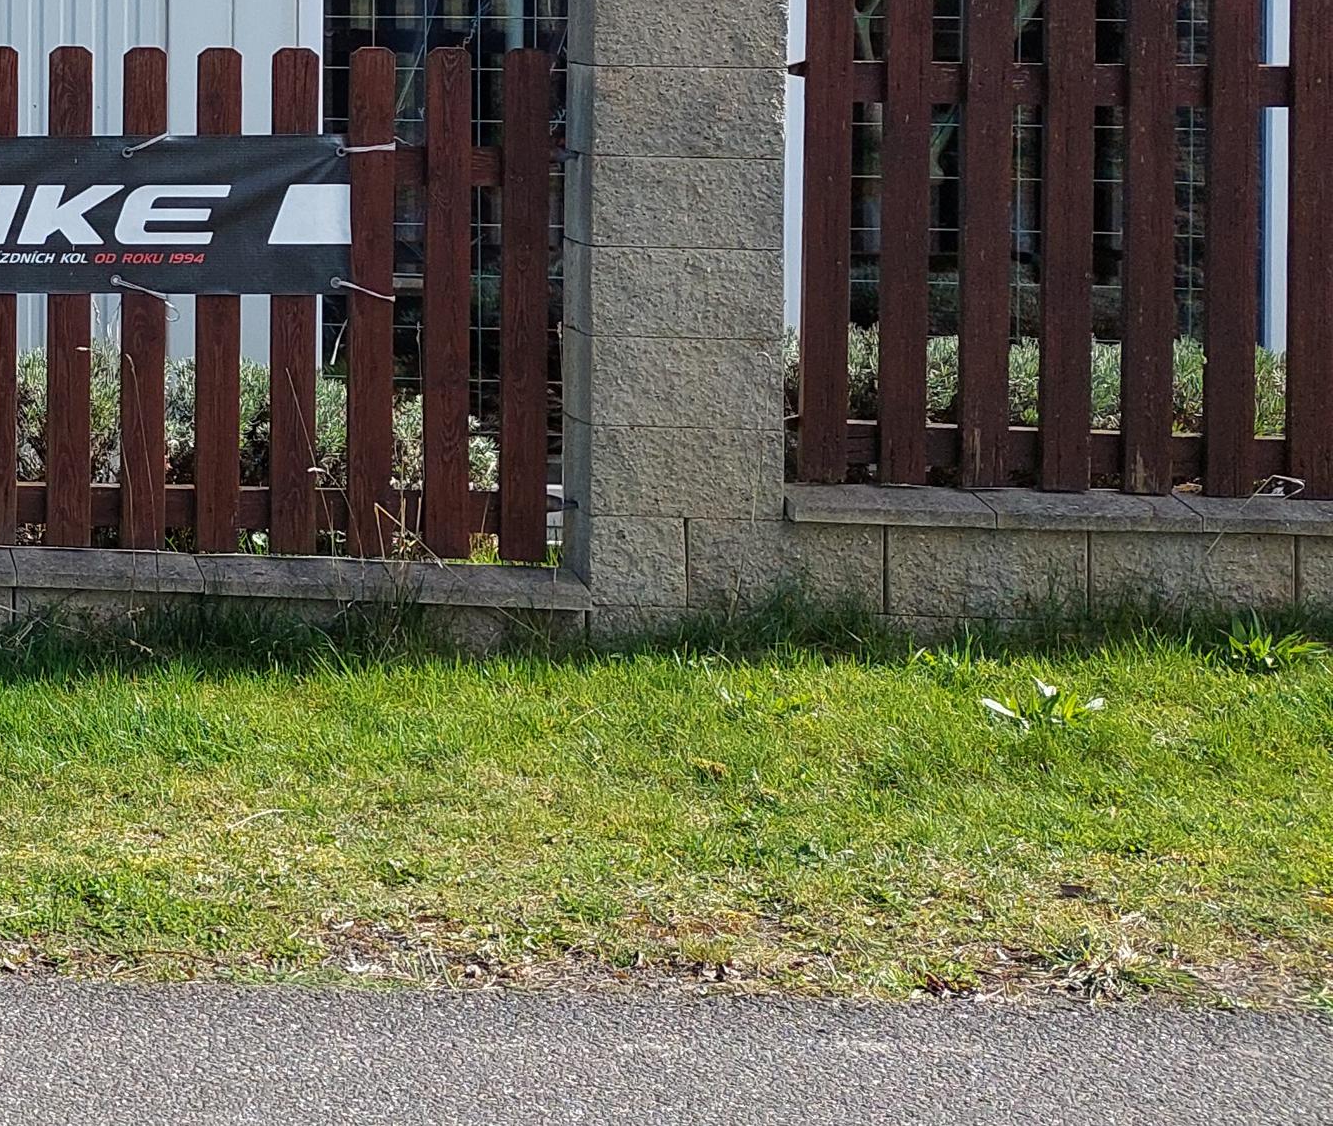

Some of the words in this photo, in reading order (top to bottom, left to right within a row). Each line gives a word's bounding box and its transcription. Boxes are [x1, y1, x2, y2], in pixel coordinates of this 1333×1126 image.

[59, 252, 89, 264] KOL
[94, 253, 117, 264] OD
[121, 253, 164, 264] ROKU
[168, 253, 206, 264] 1994
